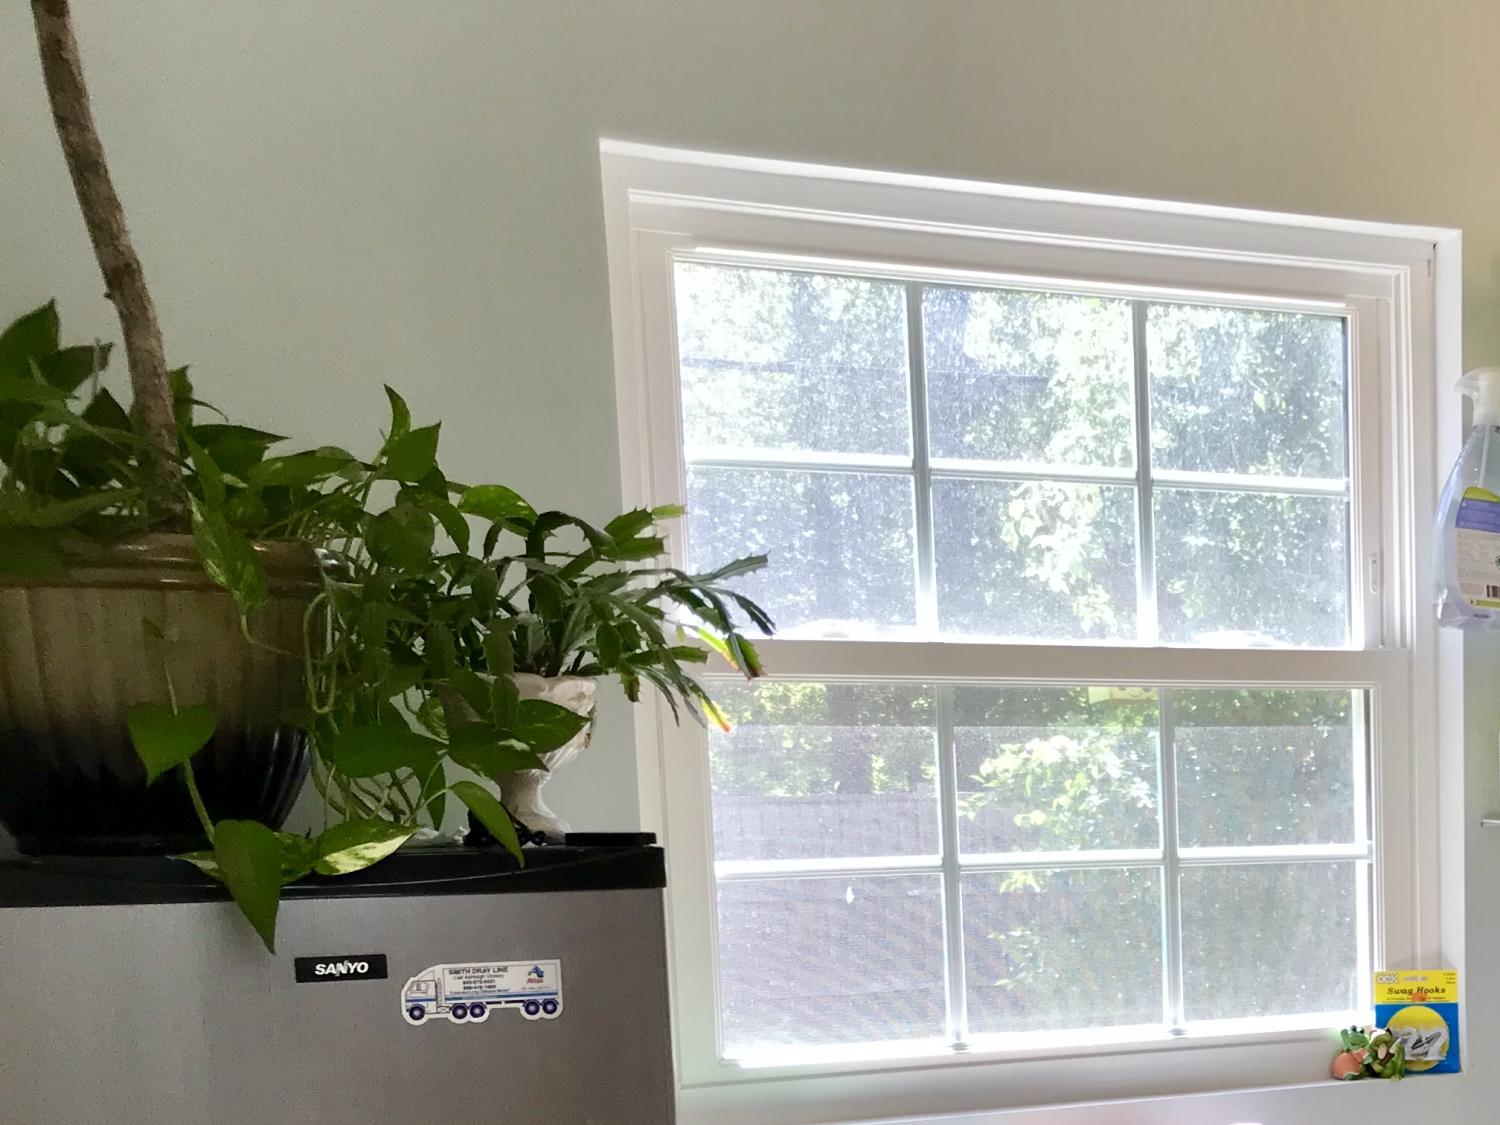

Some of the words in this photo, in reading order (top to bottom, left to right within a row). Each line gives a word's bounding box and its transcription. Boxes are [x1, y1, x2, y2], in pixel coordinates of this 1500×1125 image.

[314, 961, 369, 976] SANYO
[1387, 987, 1413, 996] Swag
[1416, 986, 1446, 994] Hooks
